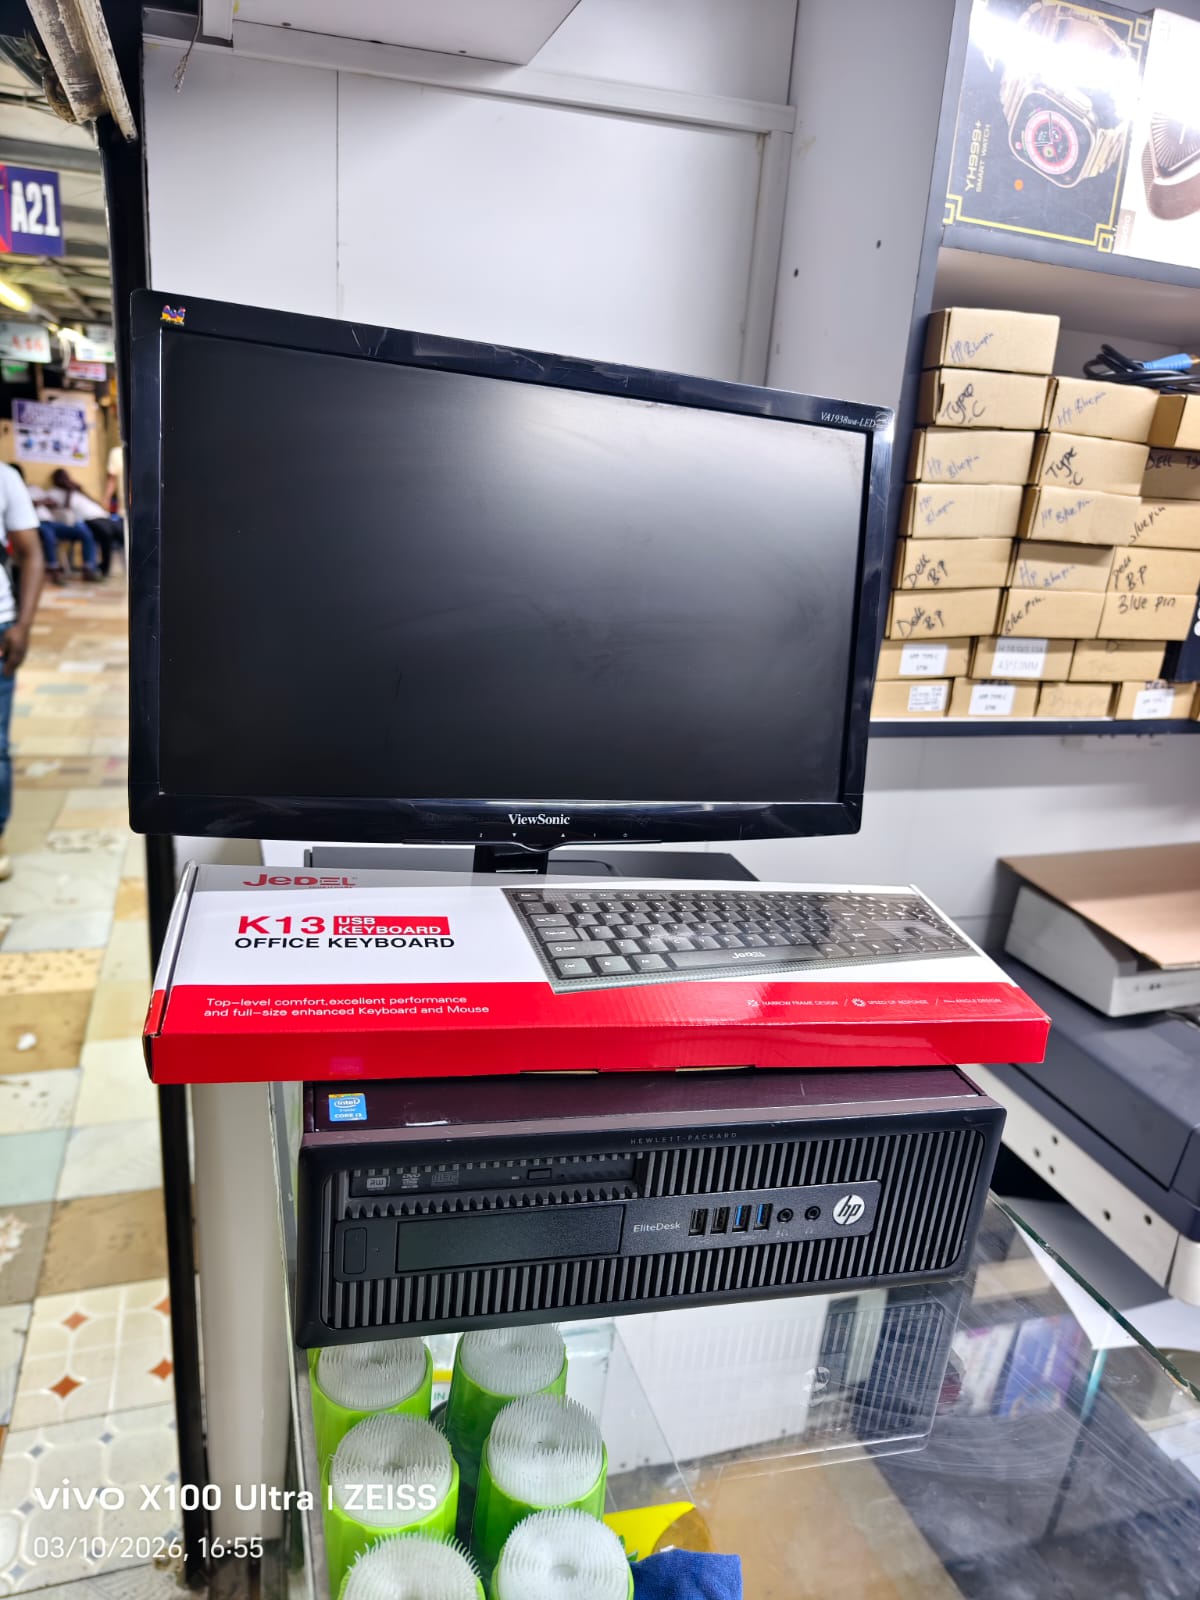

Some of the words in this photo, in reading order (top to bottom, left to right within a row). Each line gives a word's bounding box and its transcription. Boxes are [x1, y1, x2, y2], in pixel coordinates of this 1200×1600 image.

[11, 181, 61, 237] A21
[508, 813, 570, 825] ViewSonic
[238, 915, 326, 935] K13
[338, 917, 376, 926] USB
[338, 925, 441, 935] KEYBOARD
[235, 937, 319, 949] OFFICE
[328, 937, 455, 949] KEYBOARD
[206, 998, 271, 1008] Top-level
[389, 995, 468, 1006] performance
[203, 1008, 229, 1017] and
[233, 1007, 288, 1017] full-size
[291, 1007, 354, 1016] enhanced
[358, 1005, 417, 1016] Keyboard
[420, 1005, 444, 1014] and
[447, 1004, 490, 1014] Mouse
[630, 1132, 738, 1145] HEWLETT-PACKARD
[837, 1195, 862, 1224] hp
[633, 1221, 681, 1233] EliteDesk
